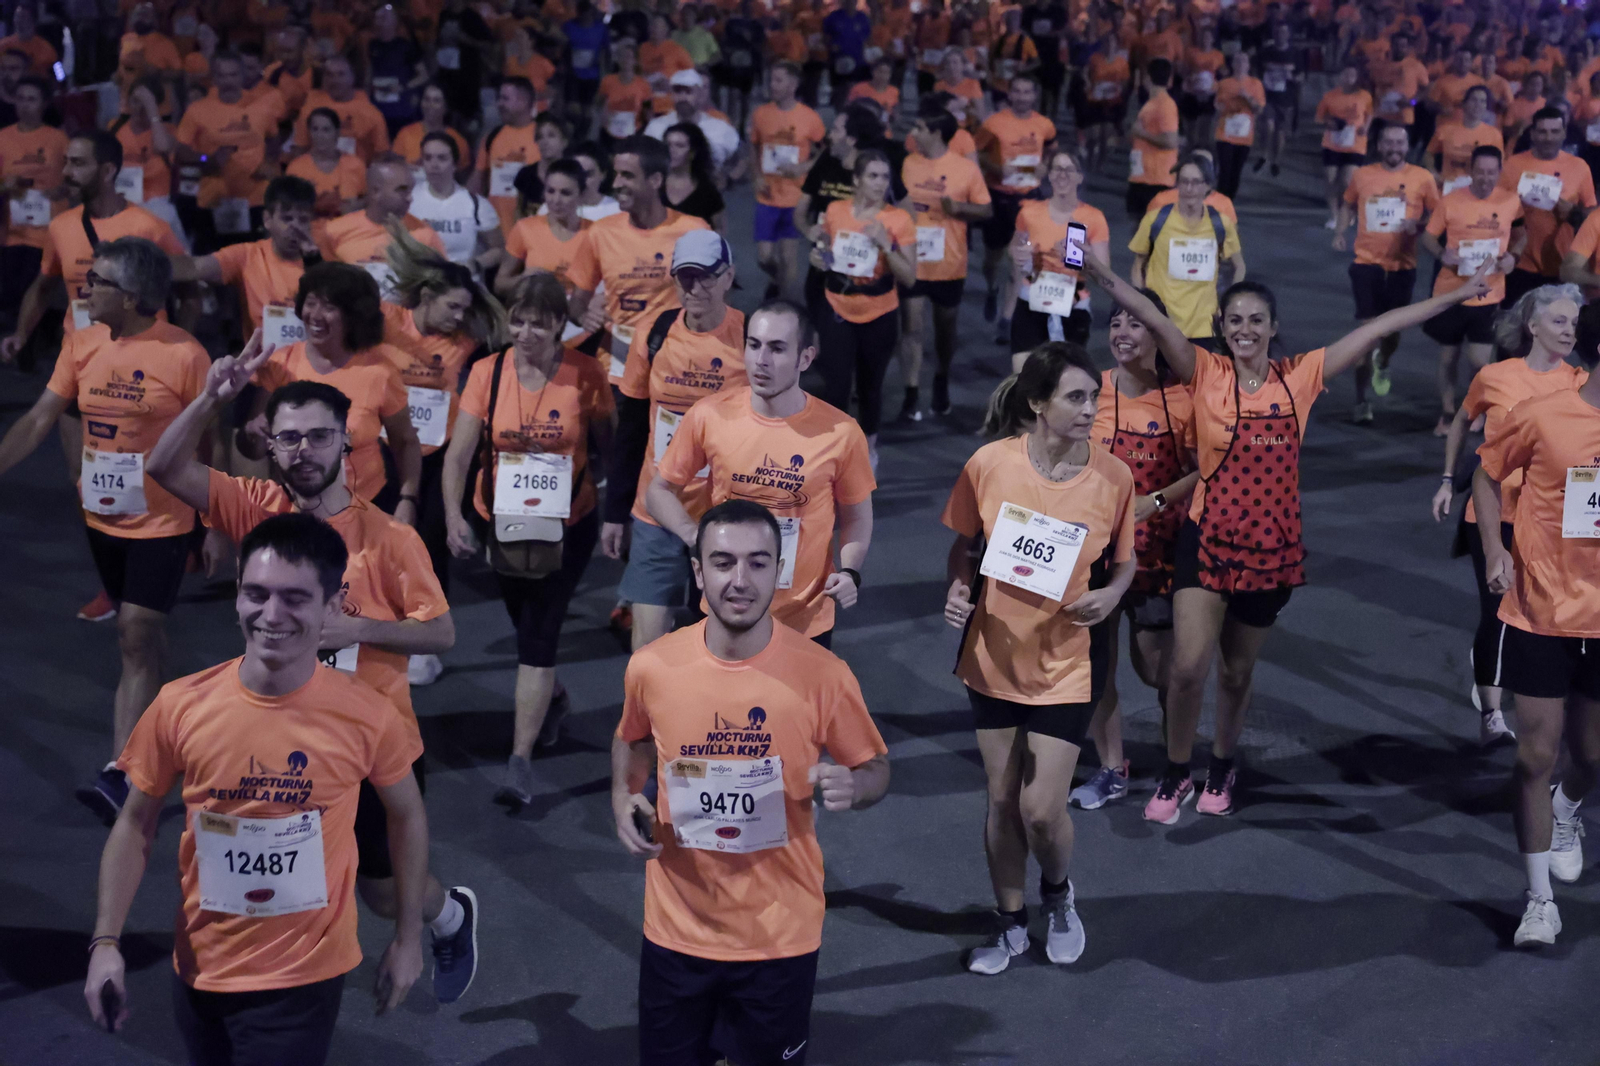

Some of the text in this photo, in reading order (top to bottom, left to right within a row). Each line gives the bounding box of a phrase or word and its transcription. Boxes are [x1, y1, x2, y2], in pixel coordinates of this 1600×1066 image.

[1181, 252, 1208, 264] 10831
[664, 375, 699, 388] SEVILLA
[682, 371, 725, 382] NOCTURNA
[89, 387, 122, 399] SEVILLA
[107, 382, 146, 393] NOCTURNA
[1250, 436, 1290, 446] SEVILLA
[92, 472, 125, 490] 4174
[755, 467, 805, 483] NOCTURNA
[513, 473, 558, 491] 21686
[731, 473, 803, 493] SEVILLA KH7
[1012, 535, 1055, 563] 4663
[706, 732, 772, 743] NOCTURNA
[680, 744, 771, 757] SEVILLA KH7
[239, 776, 313, 789] NOCTURNA
[208, 787, 311, 804] SEVILLA KH7
[700, 792, 755, 815] 9470
[224, 849, 299, 876] 12487
